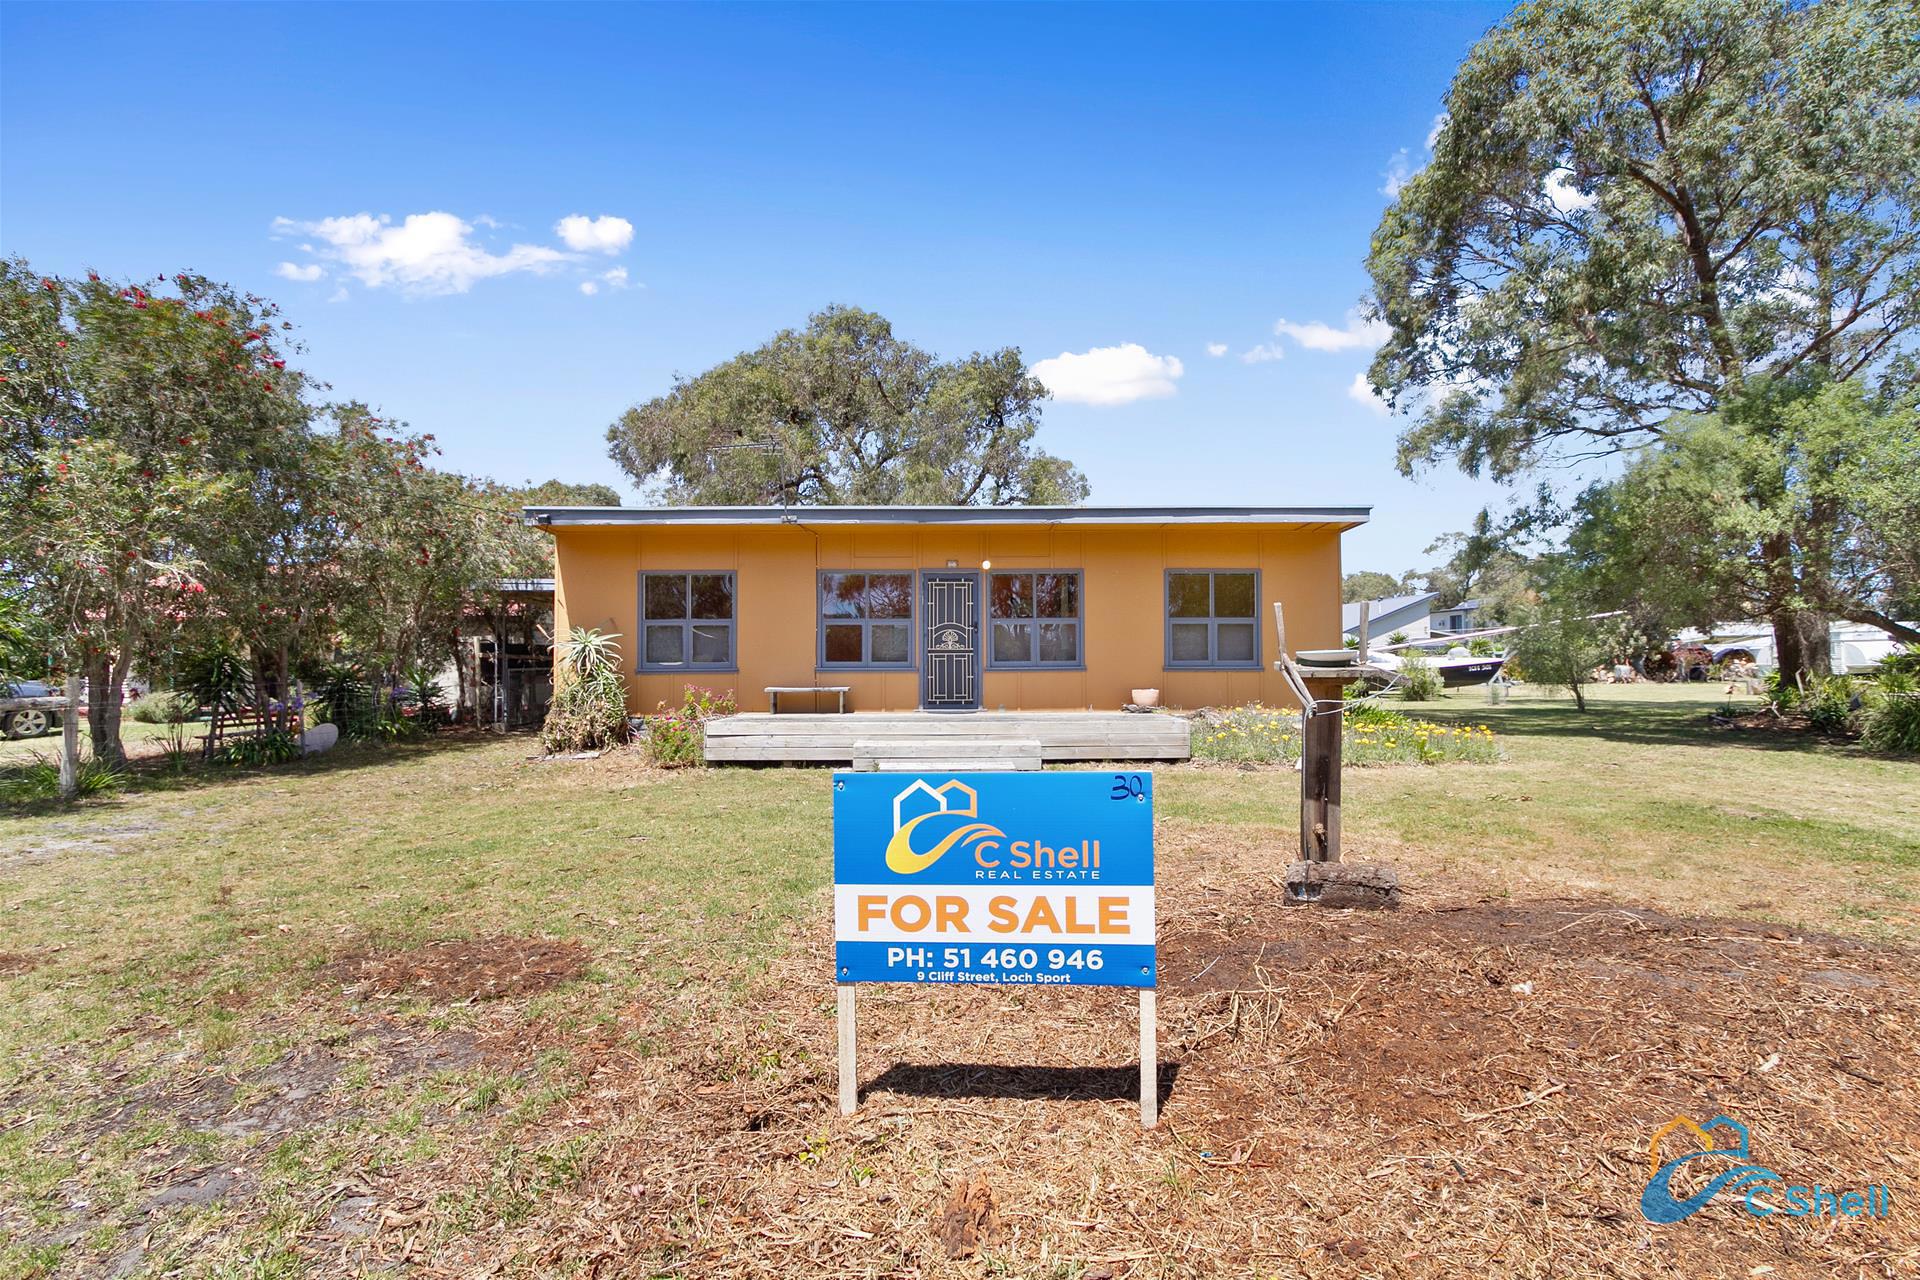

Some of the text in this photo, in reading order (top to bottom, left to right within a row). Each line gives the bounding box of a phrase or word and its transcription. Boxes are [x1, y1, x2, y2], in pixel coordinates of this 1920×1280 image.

[1110, 775, 1143, 800] 30
[974, 840, 1100, 868] C Shell
[975, 870, 1100, 880] REAL ESTATE
[857, 894, 1131, 935] FOR SALE
[887, 948, 1104, 970] PH: 51 460 946
[917, 971, 1071, 984] 9 Cliff Street, Loch Sport
